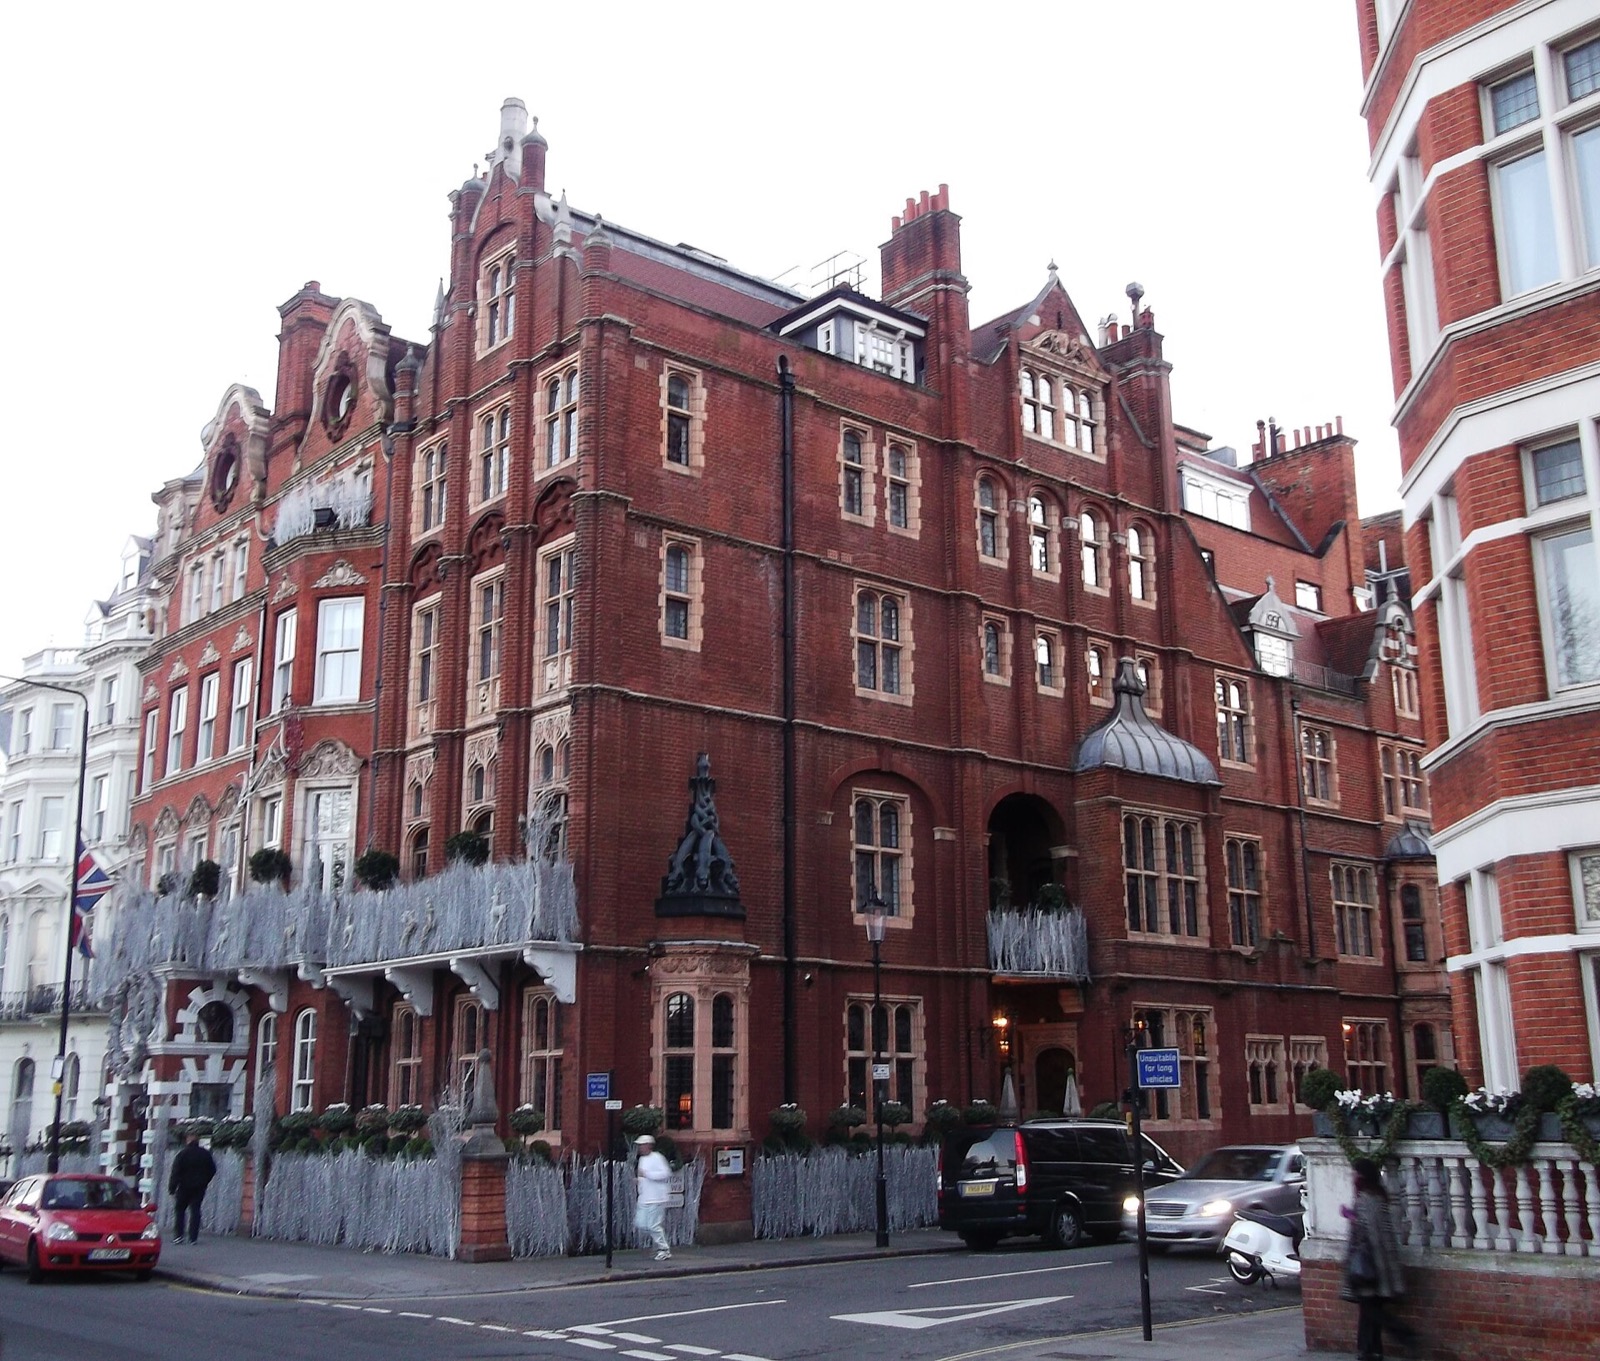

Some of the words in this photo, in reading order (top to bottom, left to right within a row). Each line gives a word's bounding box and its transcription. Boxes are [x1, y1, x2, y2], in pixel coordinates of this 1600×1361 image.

[1140, 1053, 1177, 1062] Unsuitable
[1145, 1064, 1155, 1072] for
[1157, 1064, 1173, 1073] long
[1146, 1075, 1173, 1083] vehicles
